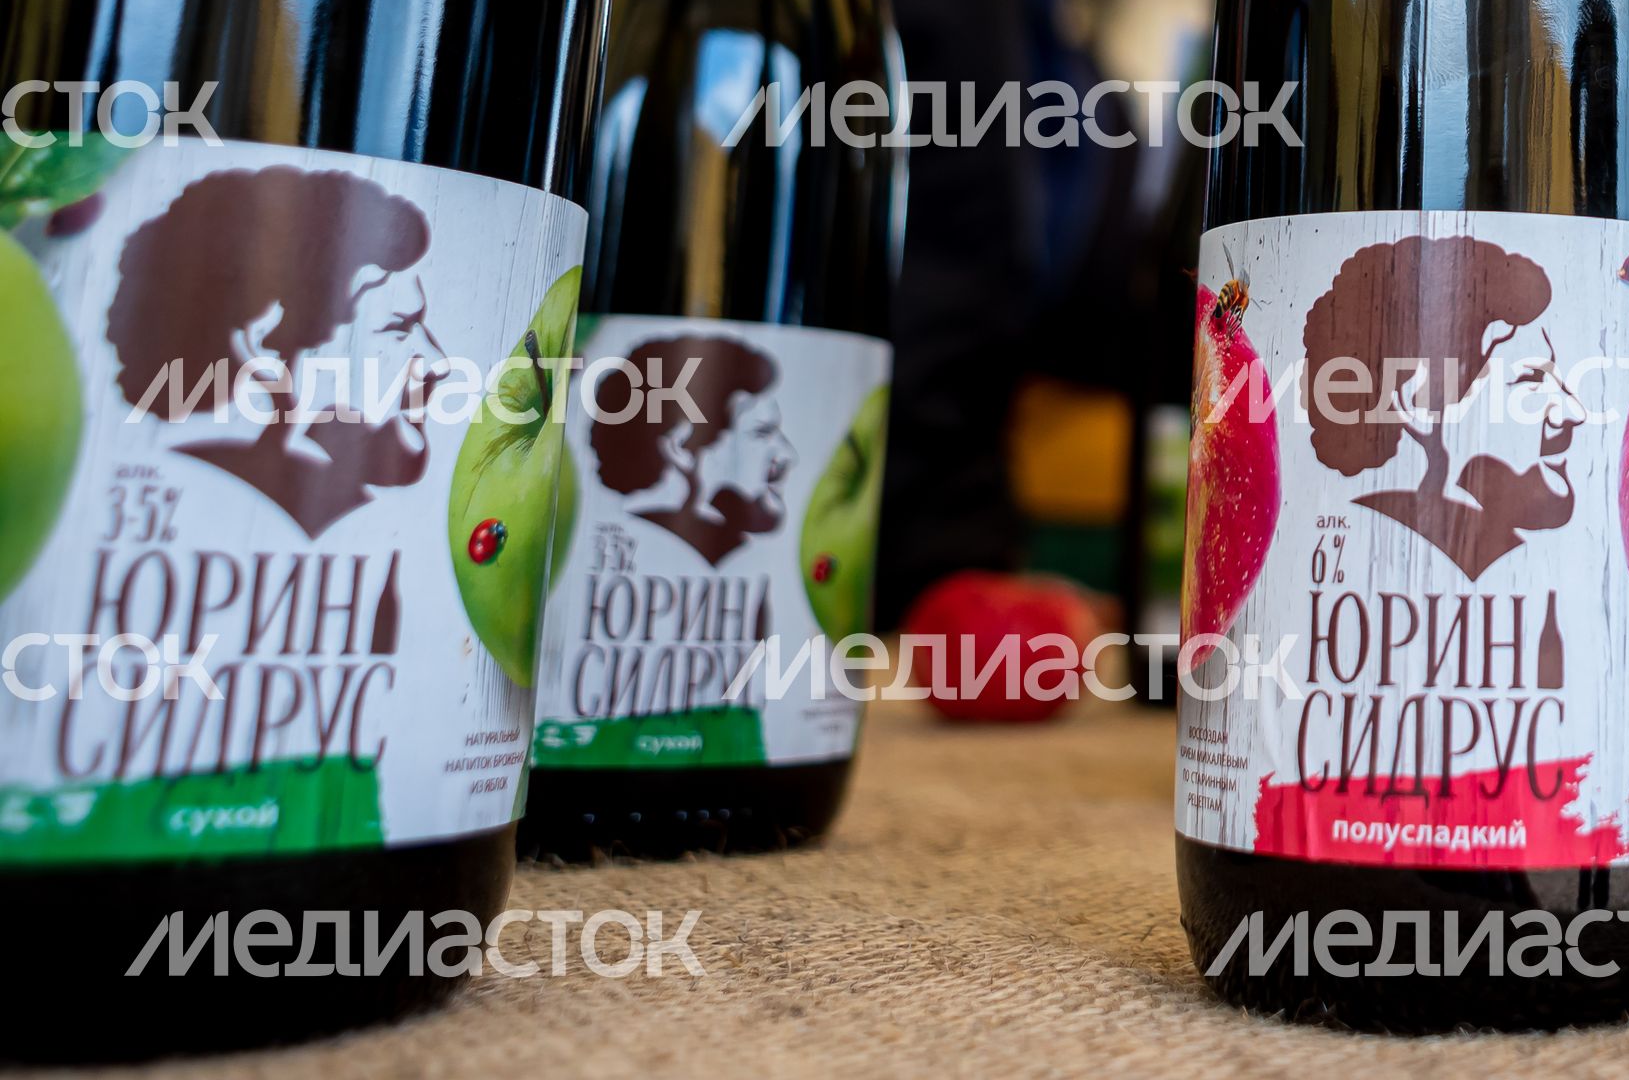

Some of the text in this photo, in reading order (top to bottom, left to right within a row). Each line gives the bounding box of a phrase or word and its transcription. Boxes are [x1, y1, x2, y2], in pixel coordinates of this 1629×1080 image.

[1311, 533, 1346, 584] 6%
[1316, 515, 1351, 529] алк.
[83, 548, 370, 656] ЮРИН
[579, 574, 748, 641] ЮРИН
[1306, 590, 1526, 689] ЮРИН
[57, 660, 396, 786] СИДРУС
[1298, 689, 1565, 808] СИДРУС
[1332, 819, 1527, 850] полусладкий
